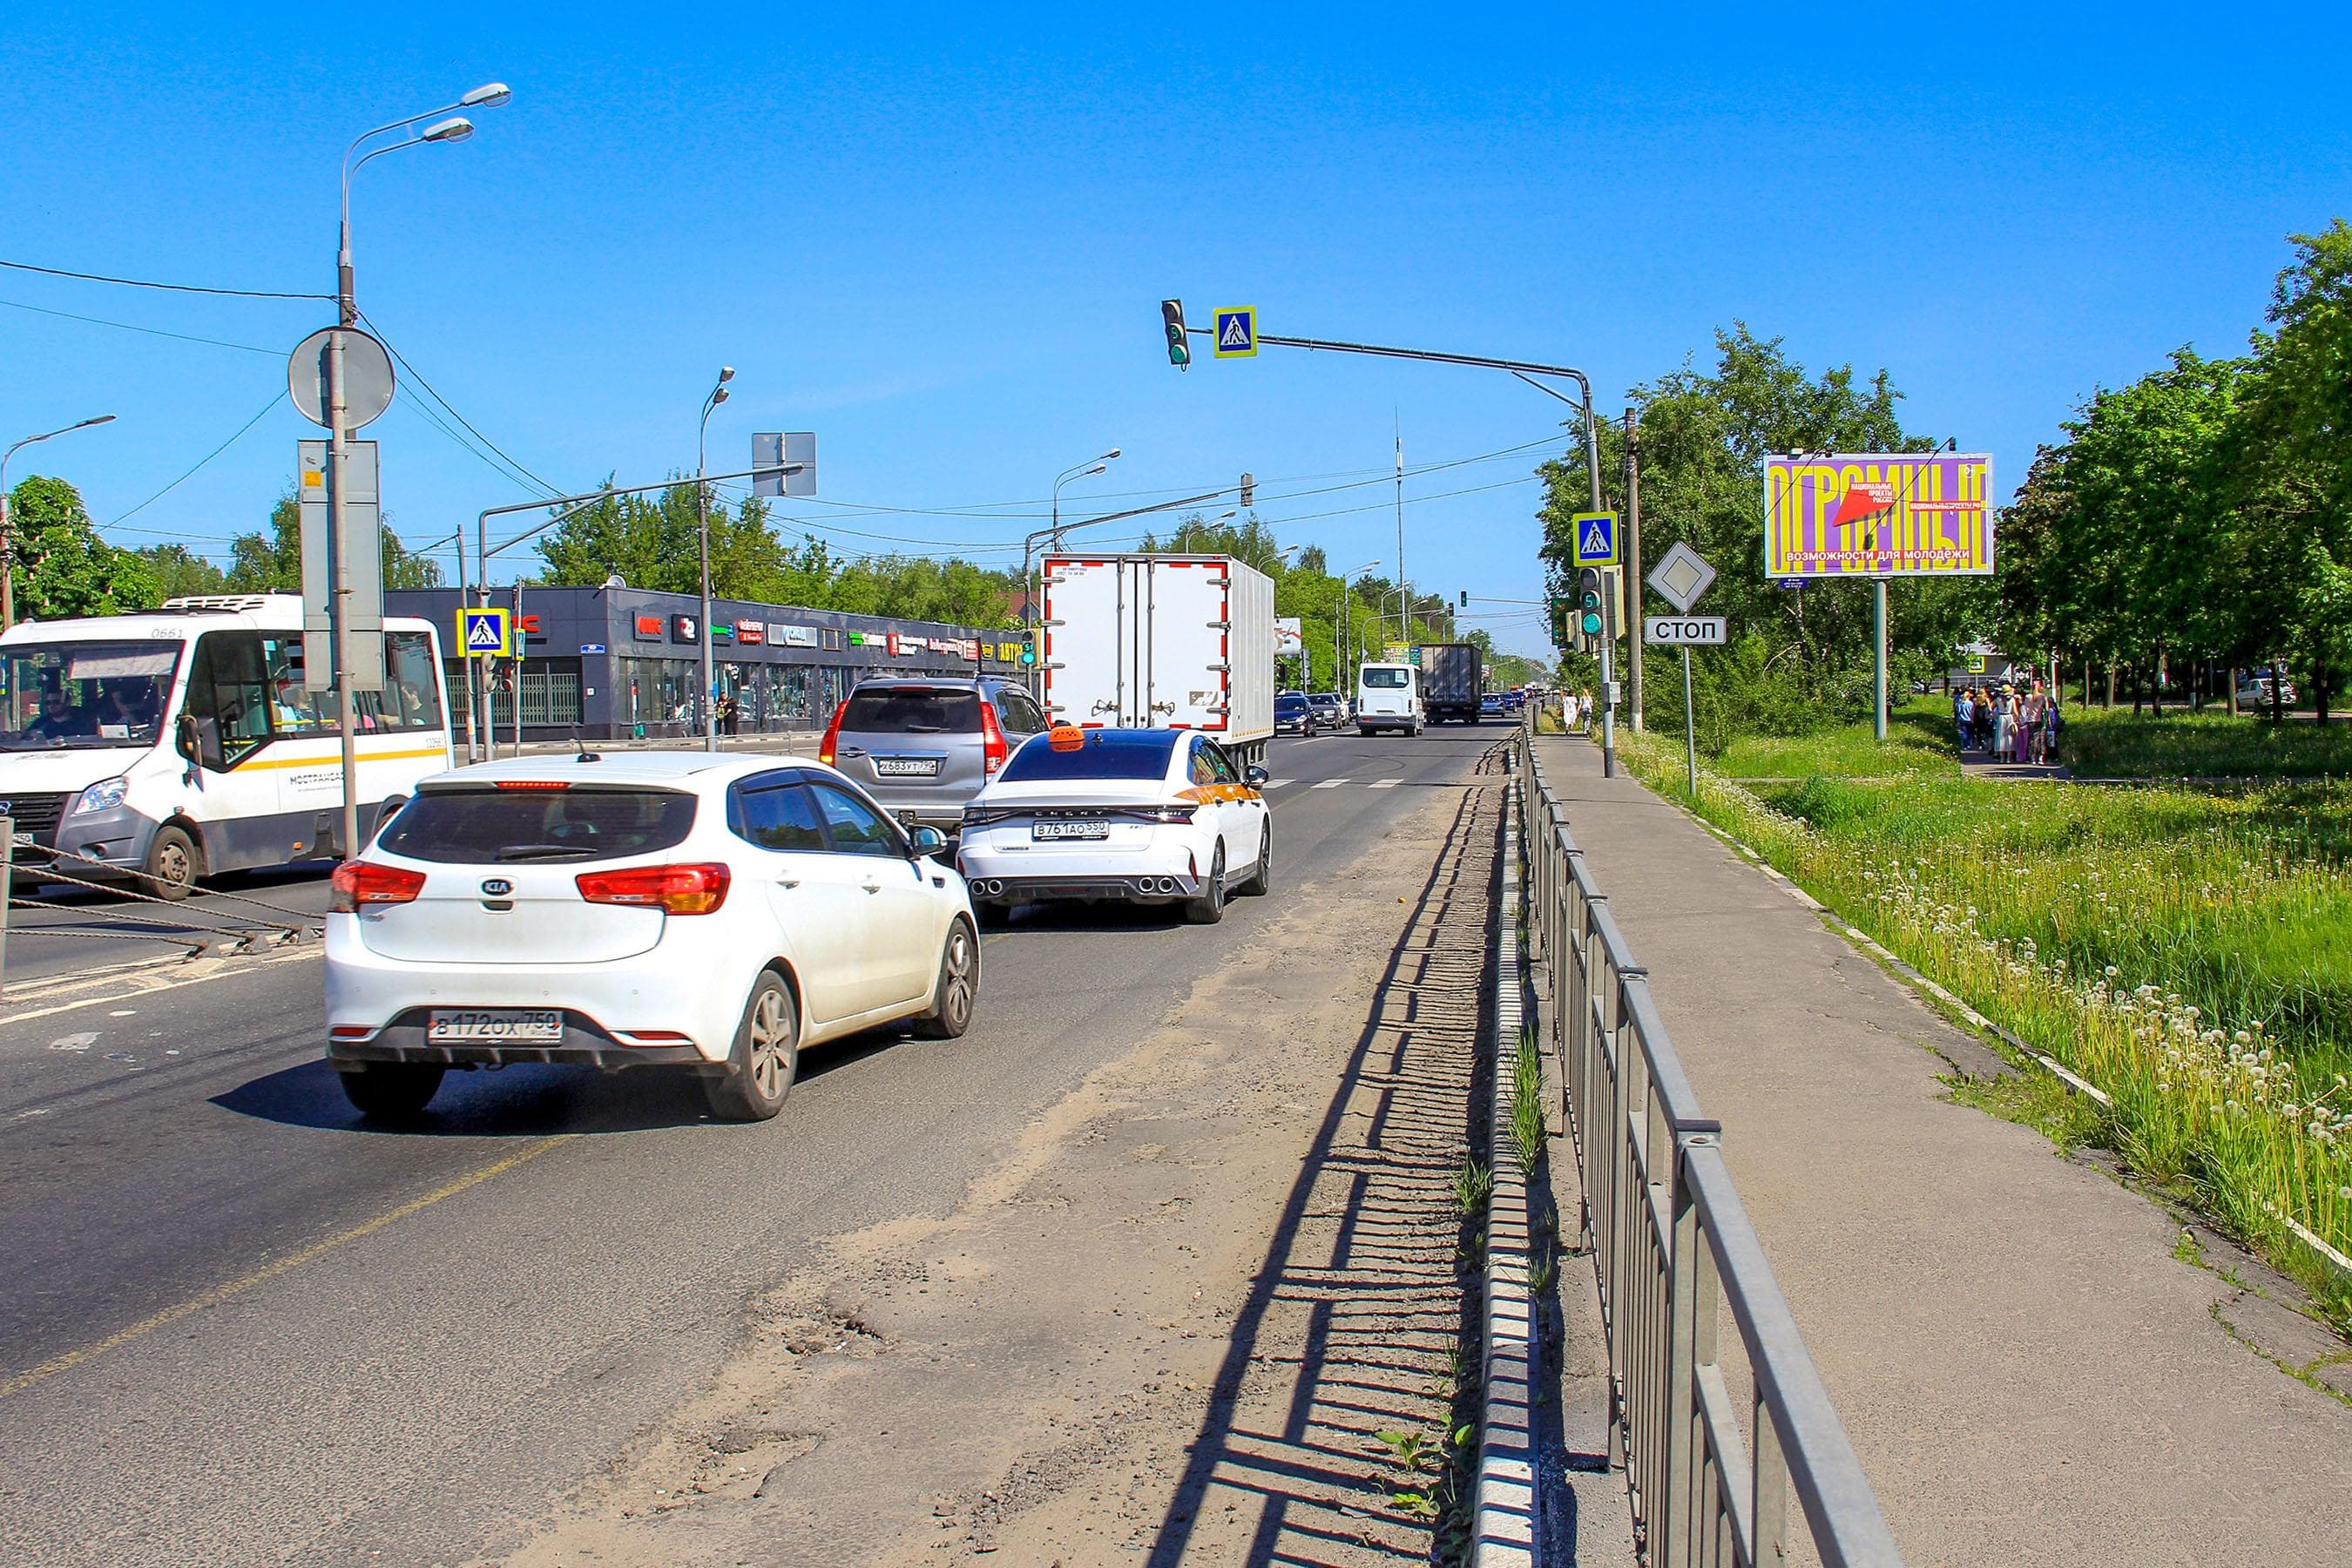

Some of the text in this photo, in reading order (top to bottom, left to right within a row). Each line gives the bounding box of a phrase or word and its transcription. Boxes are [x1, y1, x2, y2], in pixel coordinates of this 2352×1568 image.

[1877, 551, 1900, 562] для
[1585, 594, 1592, 608] 5
[151, 628, 183, 638] 0661
[1655, 622, 1715, 639] СТОП
[484, 882, 509, 893] KIA
